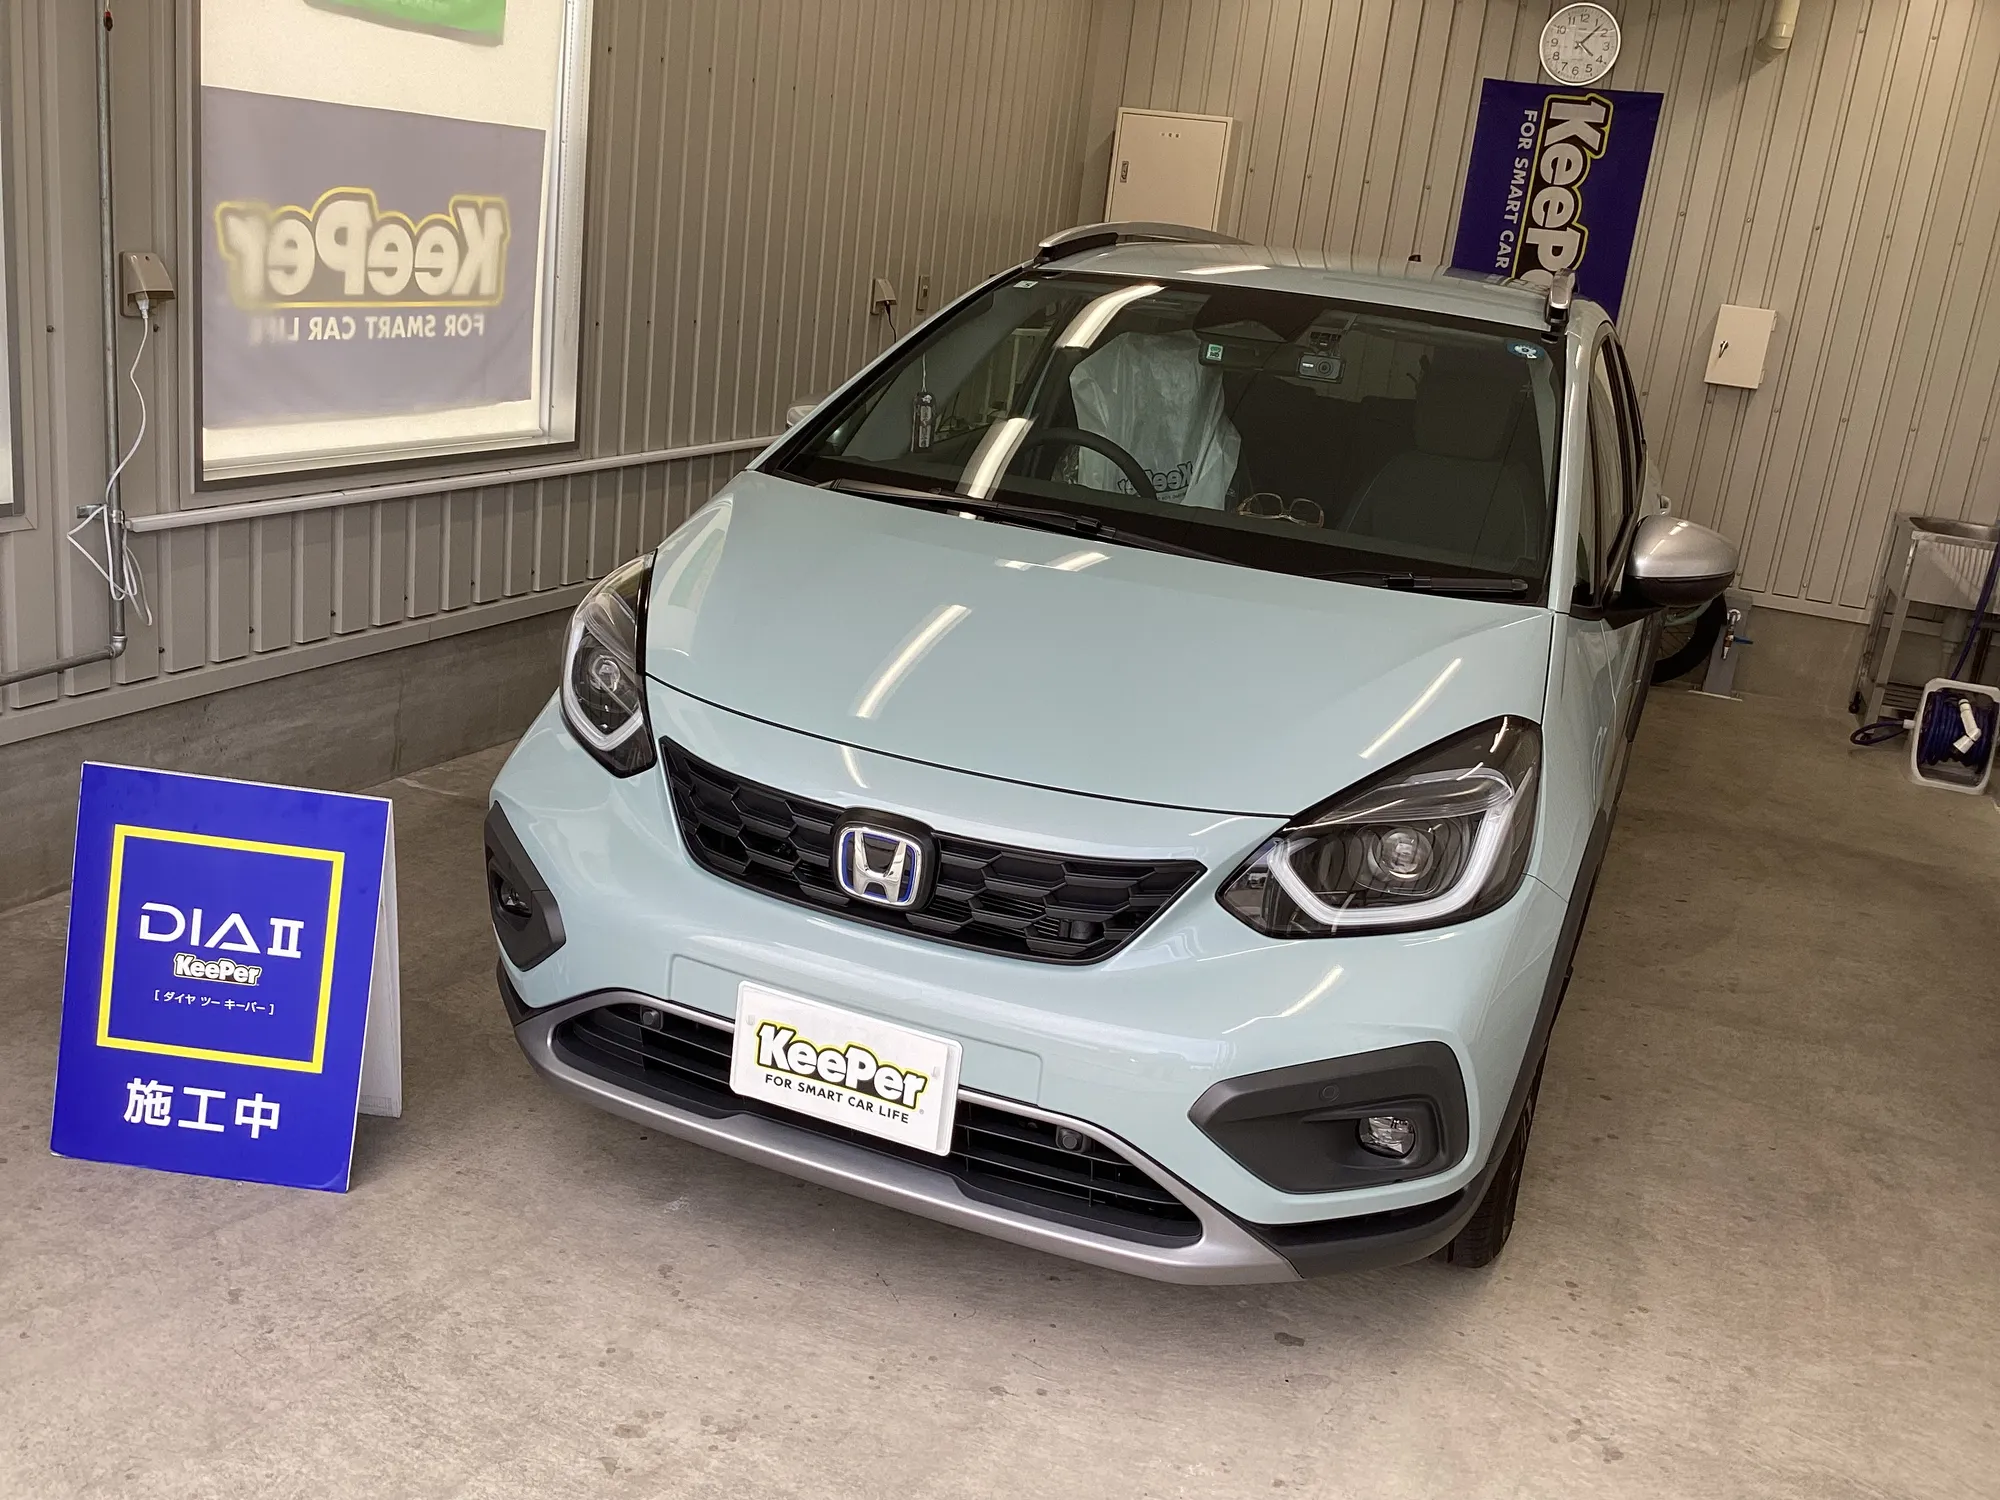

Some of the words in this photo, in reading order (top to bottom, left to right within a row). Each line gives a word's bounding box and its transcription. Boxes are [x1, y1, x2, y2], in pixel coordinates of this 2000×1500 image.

[1568, 16, 1576, 25] 11
[1580, 13, 1590, 23] 12
[1556, 25, 1567, 35] 10
[1600, 28, 1608, 38] 2
[1550, 38, 1559, 47] 9
[1602, 42, 1610, 52] 3
[1552, 52, 1560, 61] 8
[1595, 55, 1603, 64] 4
[1561, 62, 1569, 71] 7
[1571, 66, 1579, 76] 6
[1585, 64, 1593, 73] 5
[1516, 109, 1538, 150] FOR
[1503, 157, 1529, 225] SMART
[1494, 230, 1516, 269] CAR
[138, 901, 261, 954] DIA
[173, 954, 262, 986] KeePer
[757, 1023, 927, 1110] KeePer
[765, 1073, 793, 1090] FOR
[797, 1082, 844, 1103] SMART
[848, 1096, 874, 1113] CAR
[878, 1105, 910, 1124] LIFE
[123, 1076, 281, 1140] 施工中
